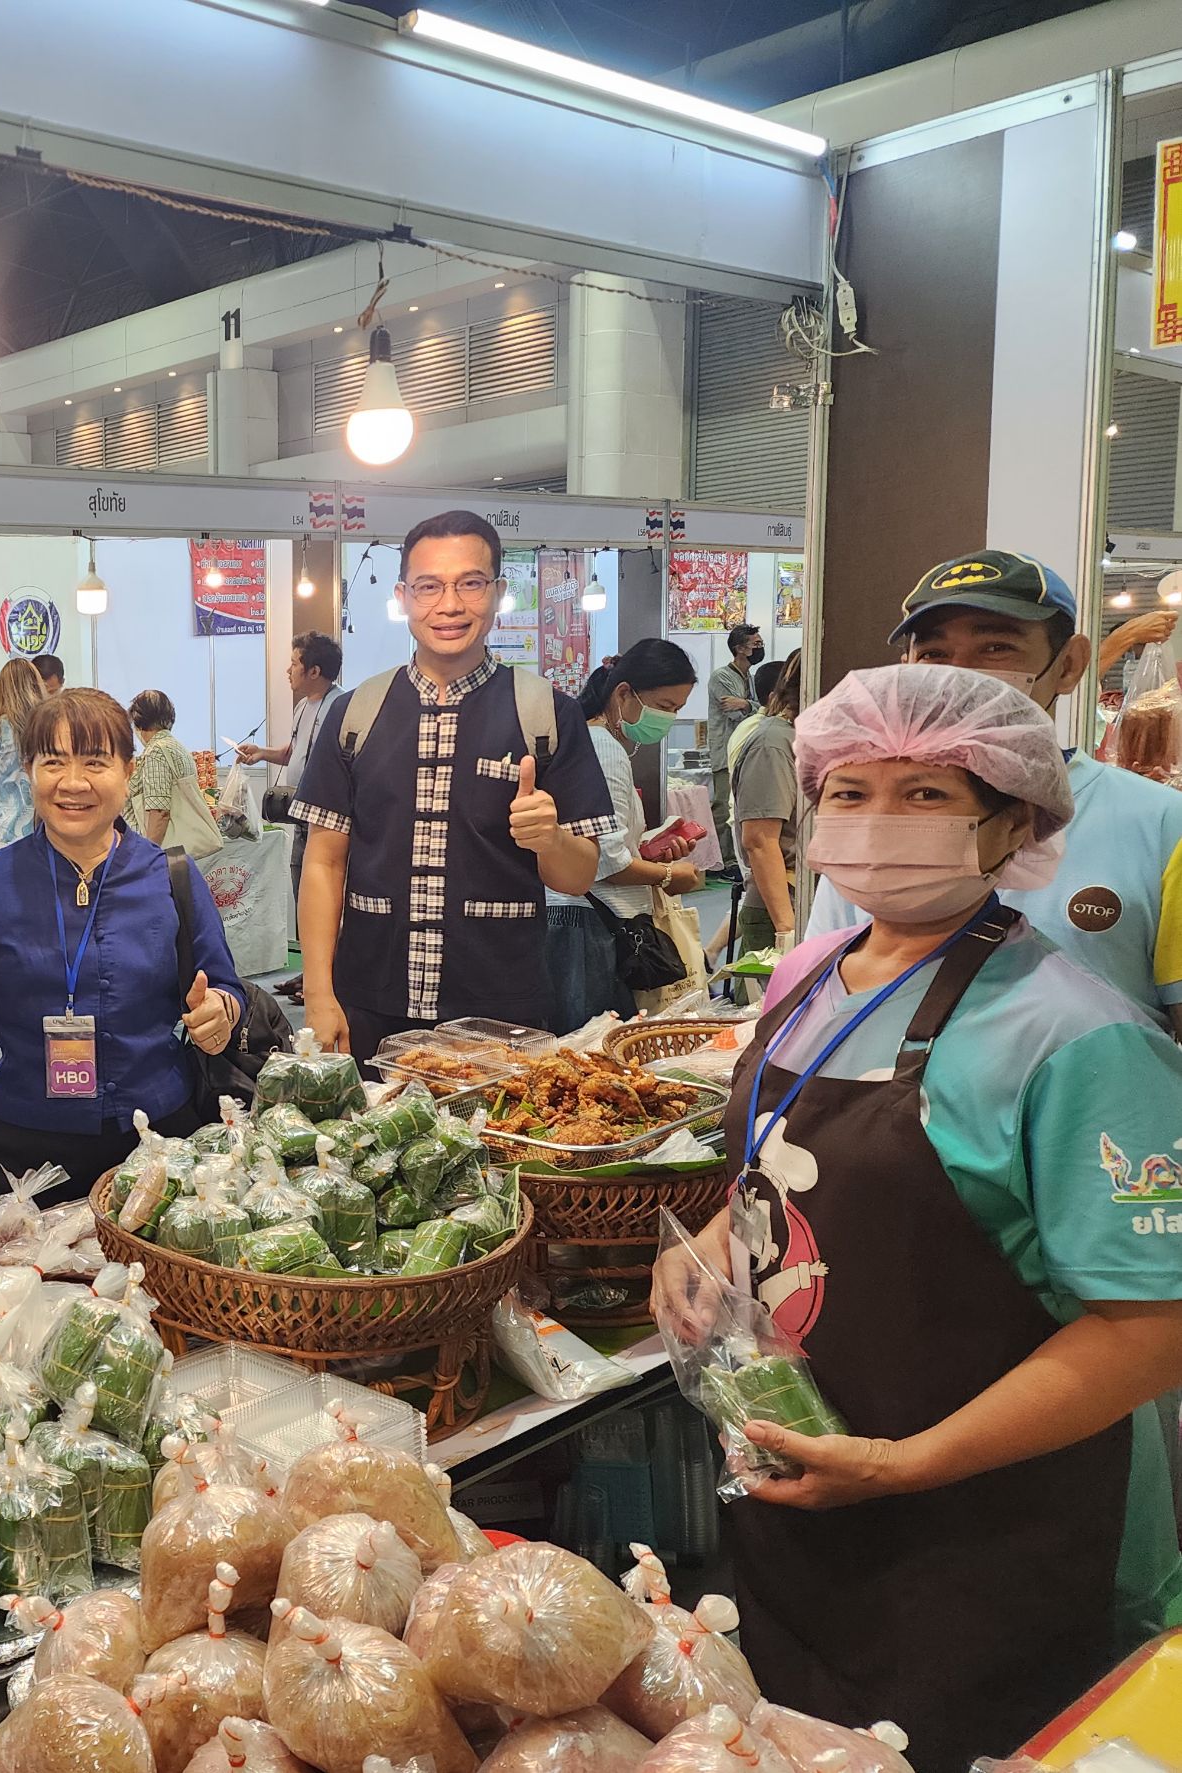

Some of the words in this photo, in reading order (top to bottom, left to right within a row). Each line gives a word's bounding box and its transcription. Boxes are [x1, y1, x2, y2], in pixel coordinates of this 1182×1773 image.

[221, 308, 241, 341] 11
[89, 488, 126, 518] สุโขทัย
[292, 515, 304, 526] L54
[1073, 903, 1115, 917] OTOP
[55, 1070, 90, 1084] KBO
